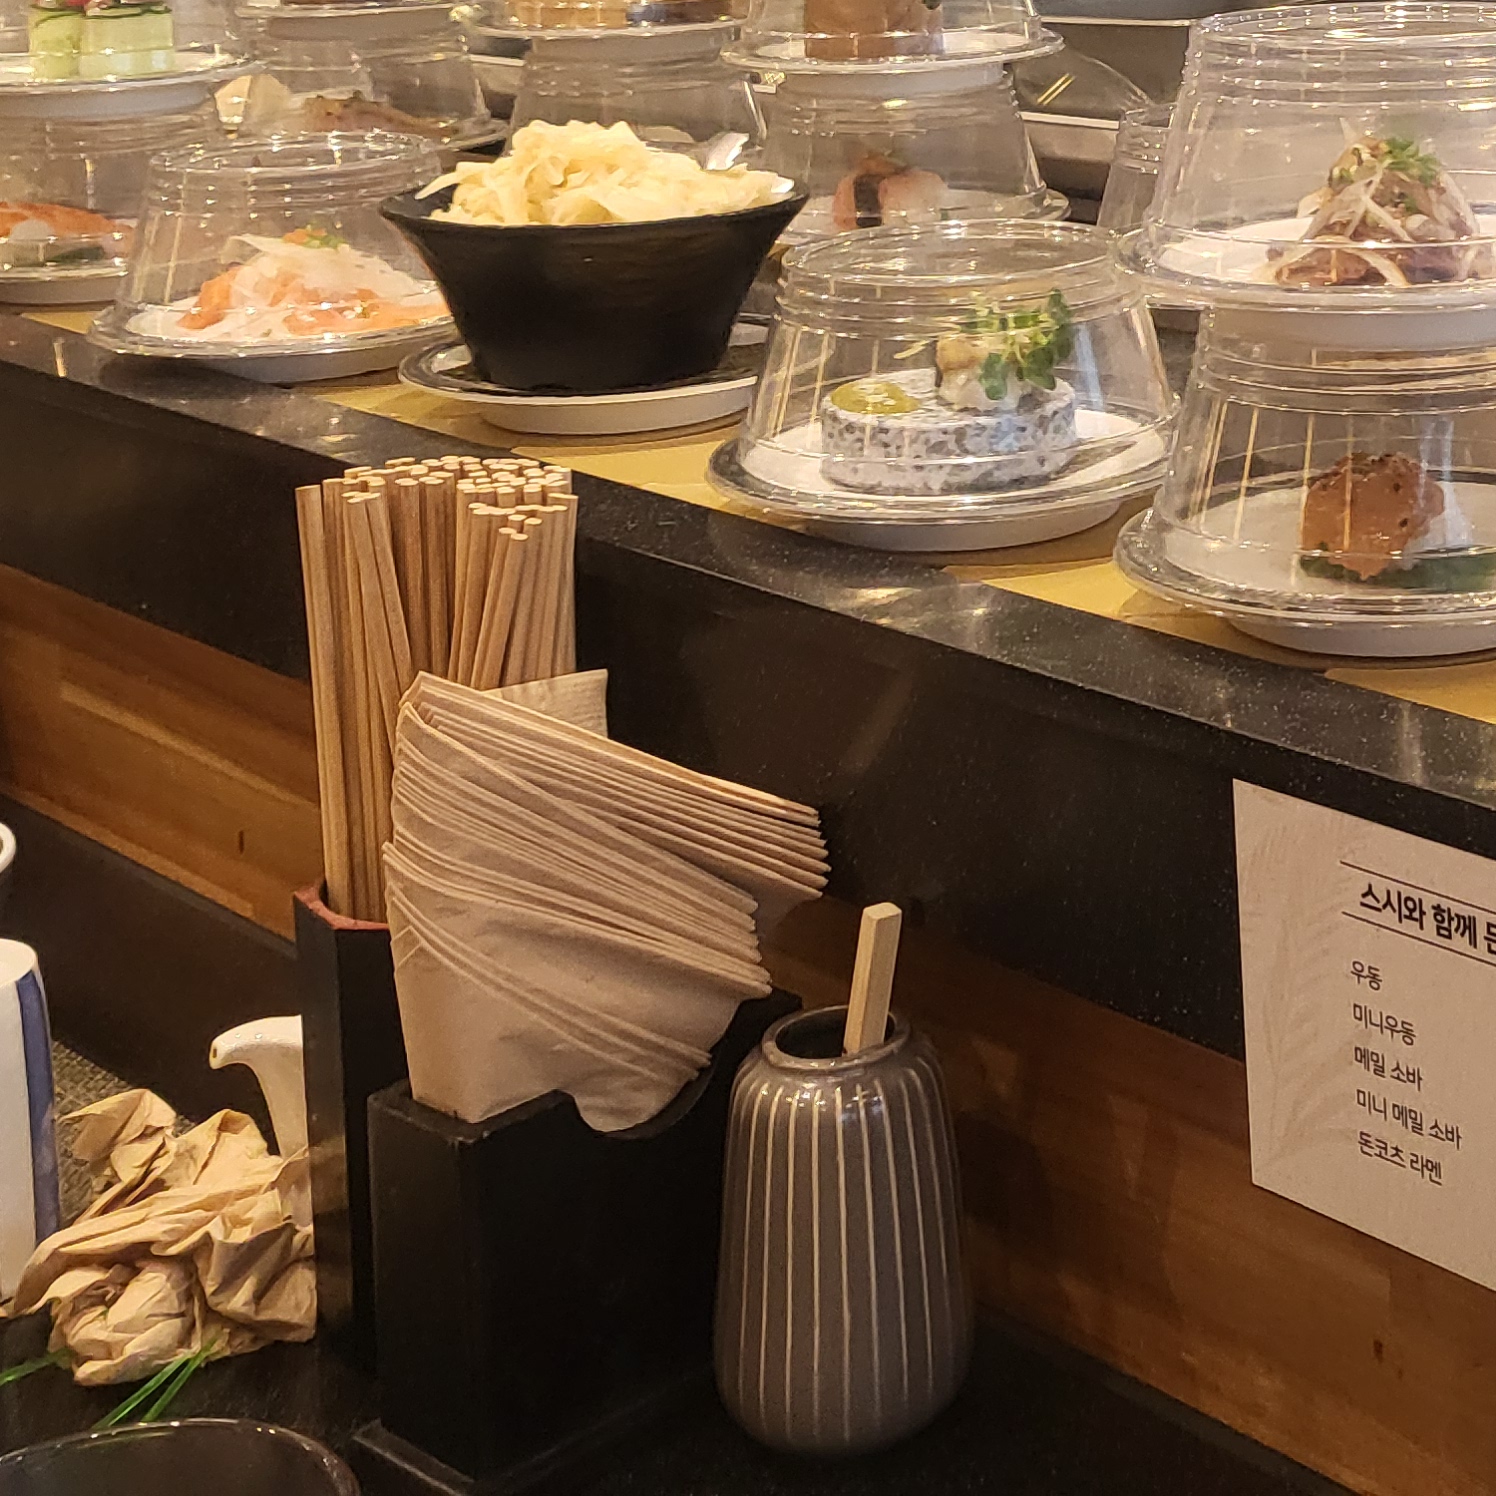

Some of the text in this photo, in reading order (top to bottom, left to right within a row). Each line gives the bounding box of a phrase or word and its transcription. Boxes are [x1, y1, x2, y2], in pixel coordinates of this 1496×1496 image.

[1360, 883, 1426, 930] 스시와
[1431, 904, 1477, 949] 함께
[1351, 961, 1382, 990] 우동
[1353, 1003, 1416, 1045] 미니우동
[1355, 1046, 1422, 1091] 메밀 소바
[1357, 1089, 1462, 1150] 미니 메밀 소바
[1358, 1131, 1442, 1186] 돈코츠 라멘
